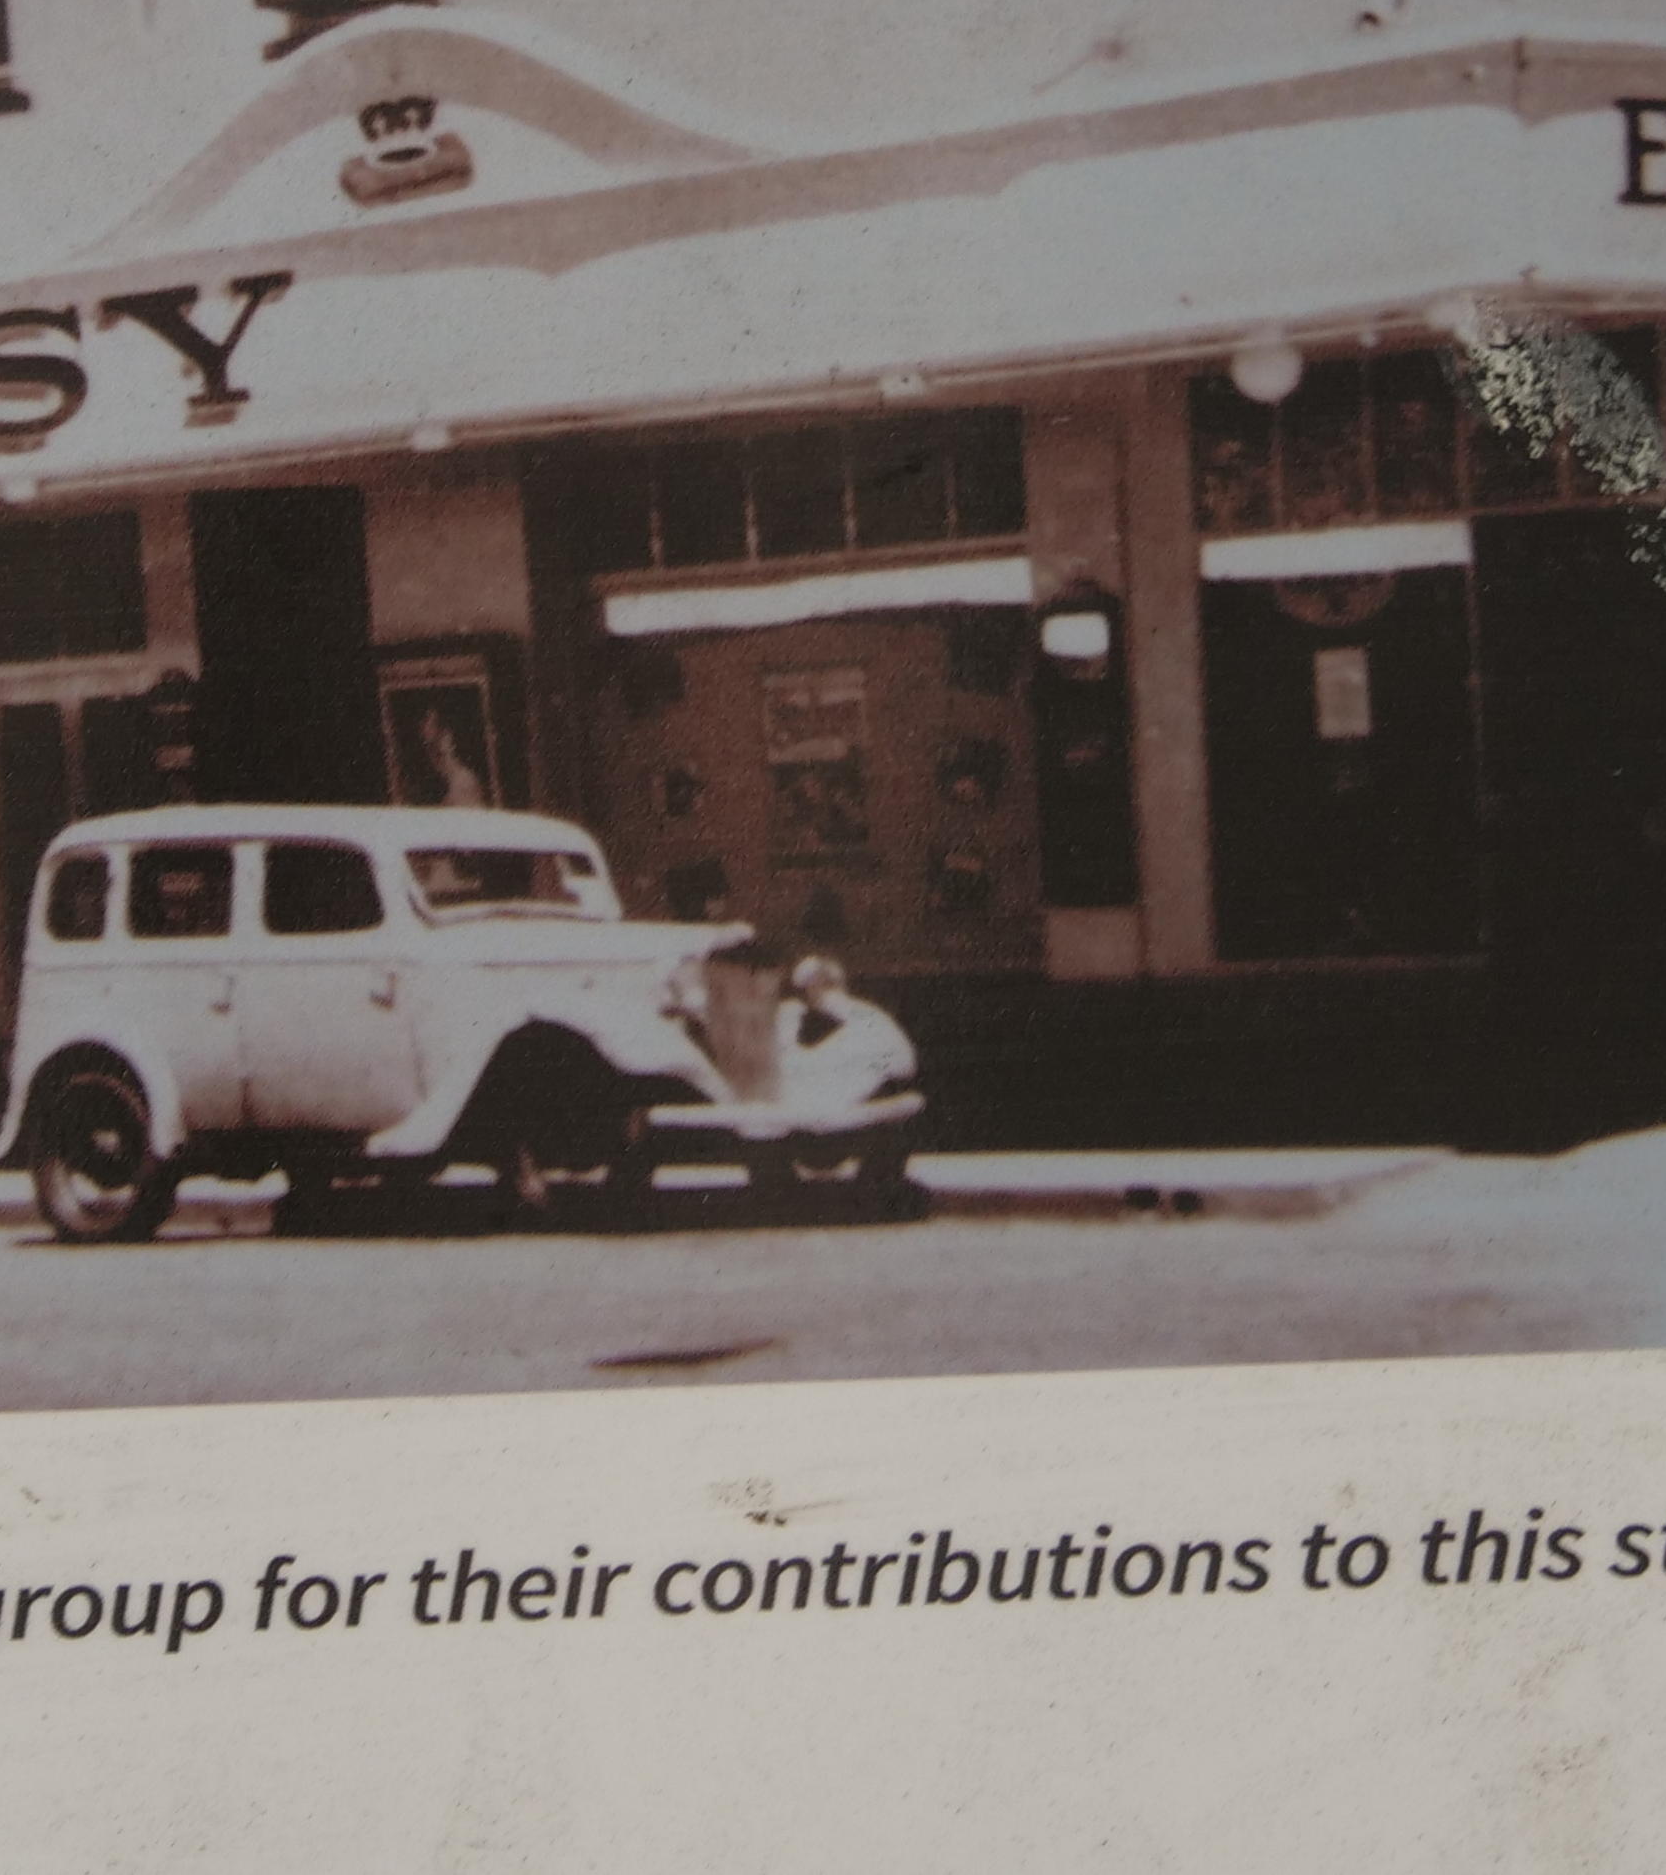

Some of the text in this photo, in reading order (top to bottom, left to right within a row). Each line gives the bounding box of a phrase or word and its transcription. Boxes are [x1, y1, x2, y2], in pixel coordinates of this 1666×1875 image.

[253, 1553, 388, 1632] for
[409, 1543, 633, 1627] their
[652, 1523, 1273, 1617] contributions
[1300, 1522, 1392, 1592] to
[1419, 1506, 1586, 1588] this
